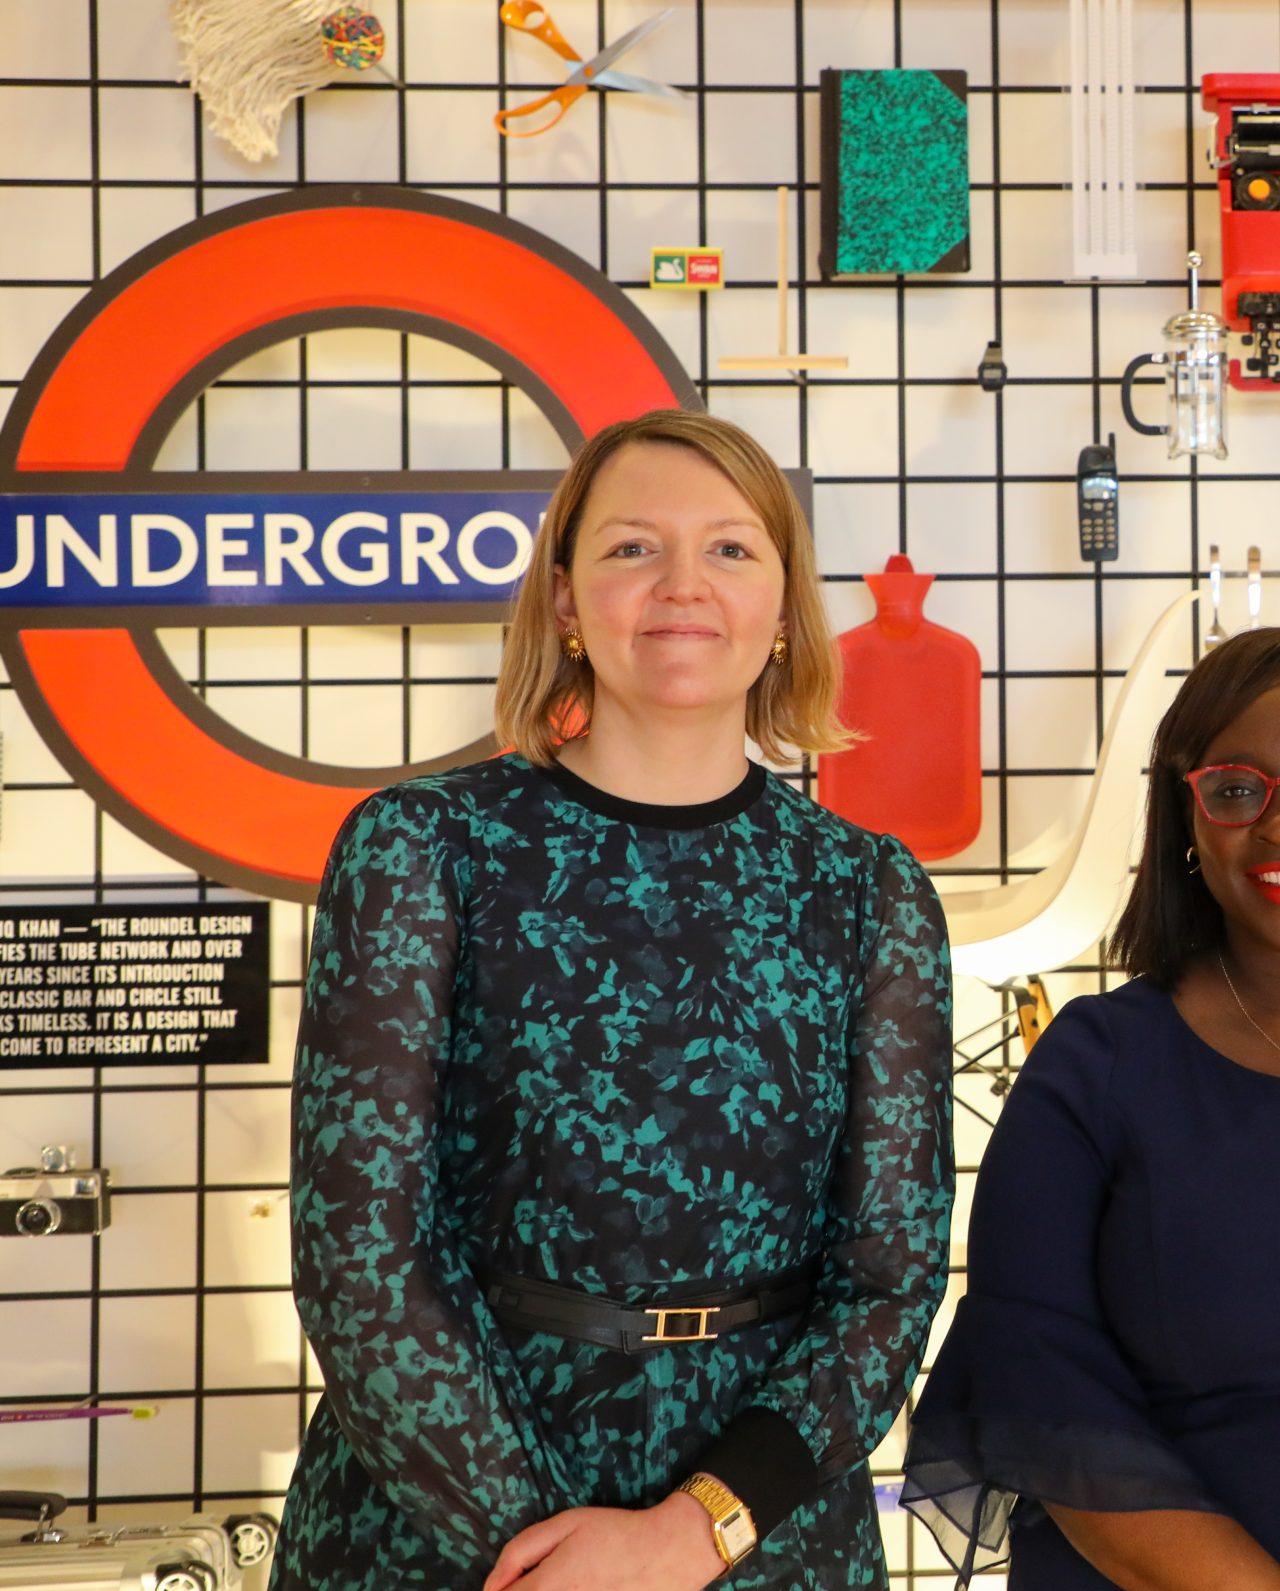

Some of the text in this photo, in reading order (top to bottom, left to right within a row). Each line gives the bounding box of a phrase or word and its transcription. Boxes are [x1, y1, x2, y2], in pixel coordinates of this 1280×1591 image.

[0, 511, 547, 589] UNDERGRO
[19, 919, 60, 938] KHAN
[130, 917, 196, 936] ROUNDEL
[199, 916, 252, 935] DESIGN
[29, 942, 57, 960] THE
[60, 942, 98, 960] TUBE
[101, 941, 168, 959] NETWORK
[171, 940, 202, 958] AND
[204, 940, 243, 958] OVER
[0, 963, 224, 985] YEARS SINCE ITS INTRODUCTION
[0, 987, 223, 1009] CLASSIC BAR AND CIRCLE STILL
[18, 1013, 92, 1032] TIMELESS.
[96, 1012, 111, 1030] IT
[113, 1012, 130, 1030] IS
[132, 1011, 143, 1029] A
[146, 1010, 199, 1029] DESIGN
[202, 1009, 238, 1028] THAT
[0, 1037, 41, 1056] COME
[45, 1037, 63, 1055] TO
[67, 1035, 149, 1054] REPRESENT
[151, 1035, 163, 1053] A
